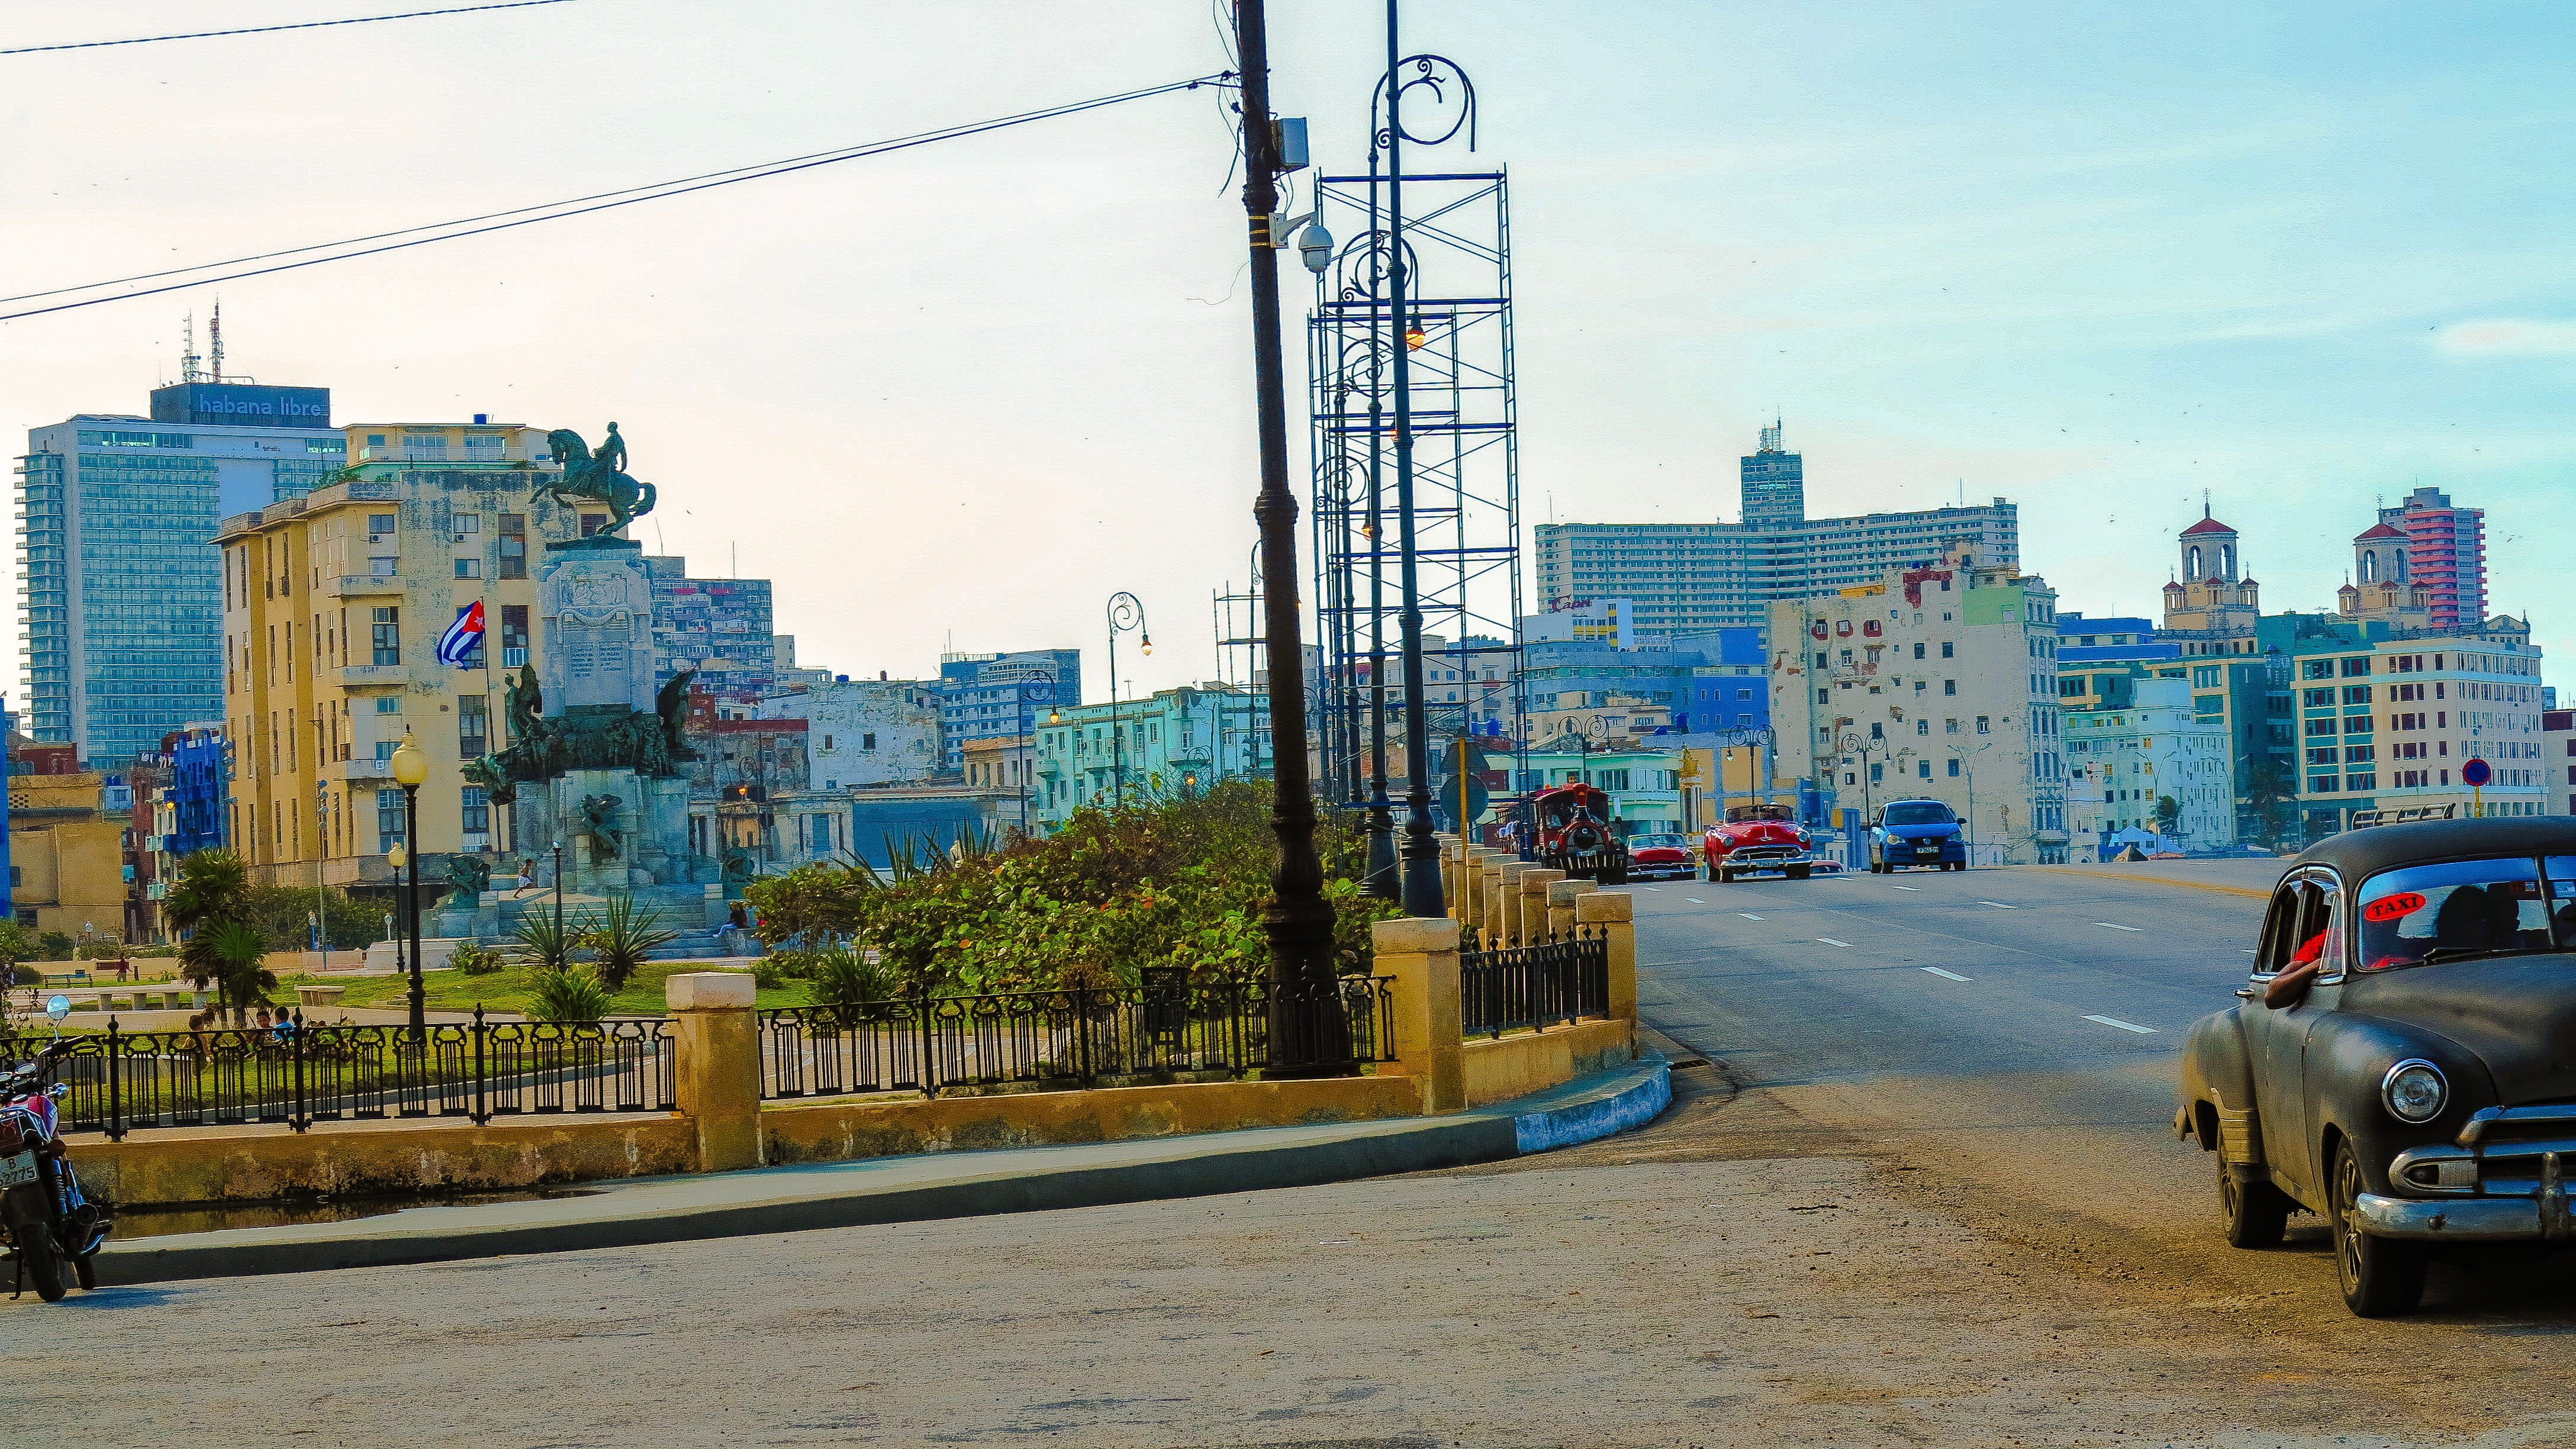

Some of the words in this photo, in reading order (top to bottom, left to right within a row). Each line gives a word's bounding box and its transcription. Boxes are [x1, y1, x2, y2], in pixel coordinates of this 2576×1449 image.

[199, 394, 272, 414] habana
[281, 396, 321, 416] libre
[2374, 897, 2417, 916] TAXI
[8, 1158, 17, 1170] B
[0, 1166, 35, 1185] 2775
